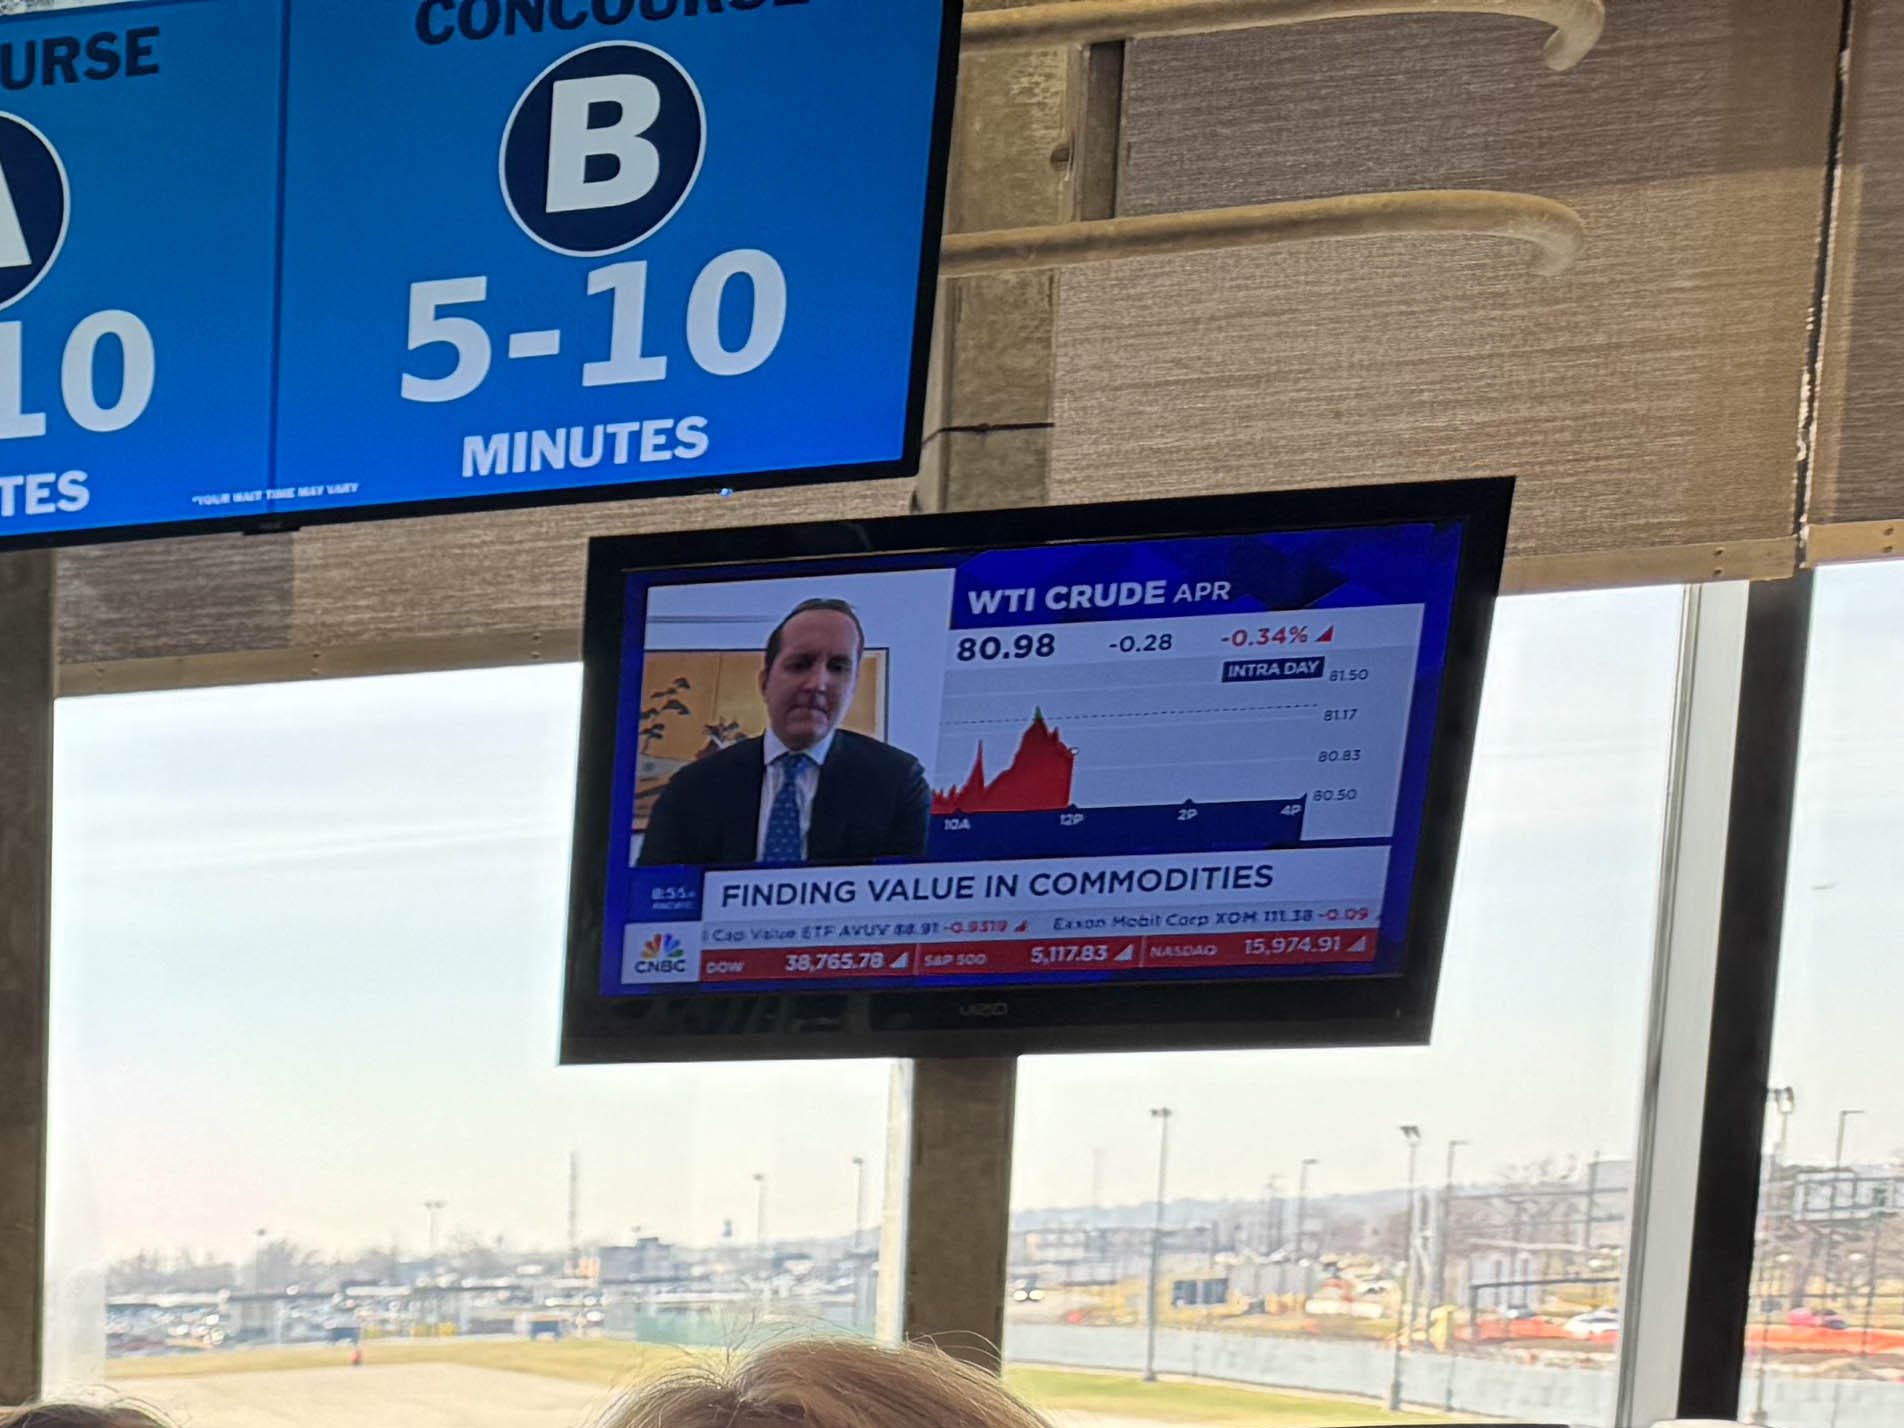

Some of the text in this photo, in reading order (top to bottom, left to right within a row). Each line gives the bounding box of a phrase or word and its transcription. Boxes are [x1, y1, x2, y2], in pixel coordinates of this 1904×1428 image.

[546, 74, 660, 213] B
[400, 248, 788, 402] 5-10
[462, 415, 710, 478] MINUTES
[968, 580, 1231, 615] WTI CRUDE APR
[957, 625, 1308, 661] 80.98 -0.28 -0.34%
[1228, 660, 1320, 679] INTRA DAY
[1329, 668, 1369, 682] 81.50
[1323, 708, 1358, 722] 81.17
[1317, 749, 1361, 763] 80.83
[1177, 807, 1198, 822] 2P
[1280, 804, 1302, 818] 4P
[722, 880, 857, 907] FINDING
[868, 876, 975, 902] VALUE
[985, 874, 1018, 898] IN
[1030, 864, 1274, 897] COMMODITIES
[1030, 944, 1109, 966] 5,117.83
[1244, 935, 1342, 956] 15,974.91
[634, 959, 687, 973] CNBC
[706, 952, 884, 975] DOW 38,765.78
